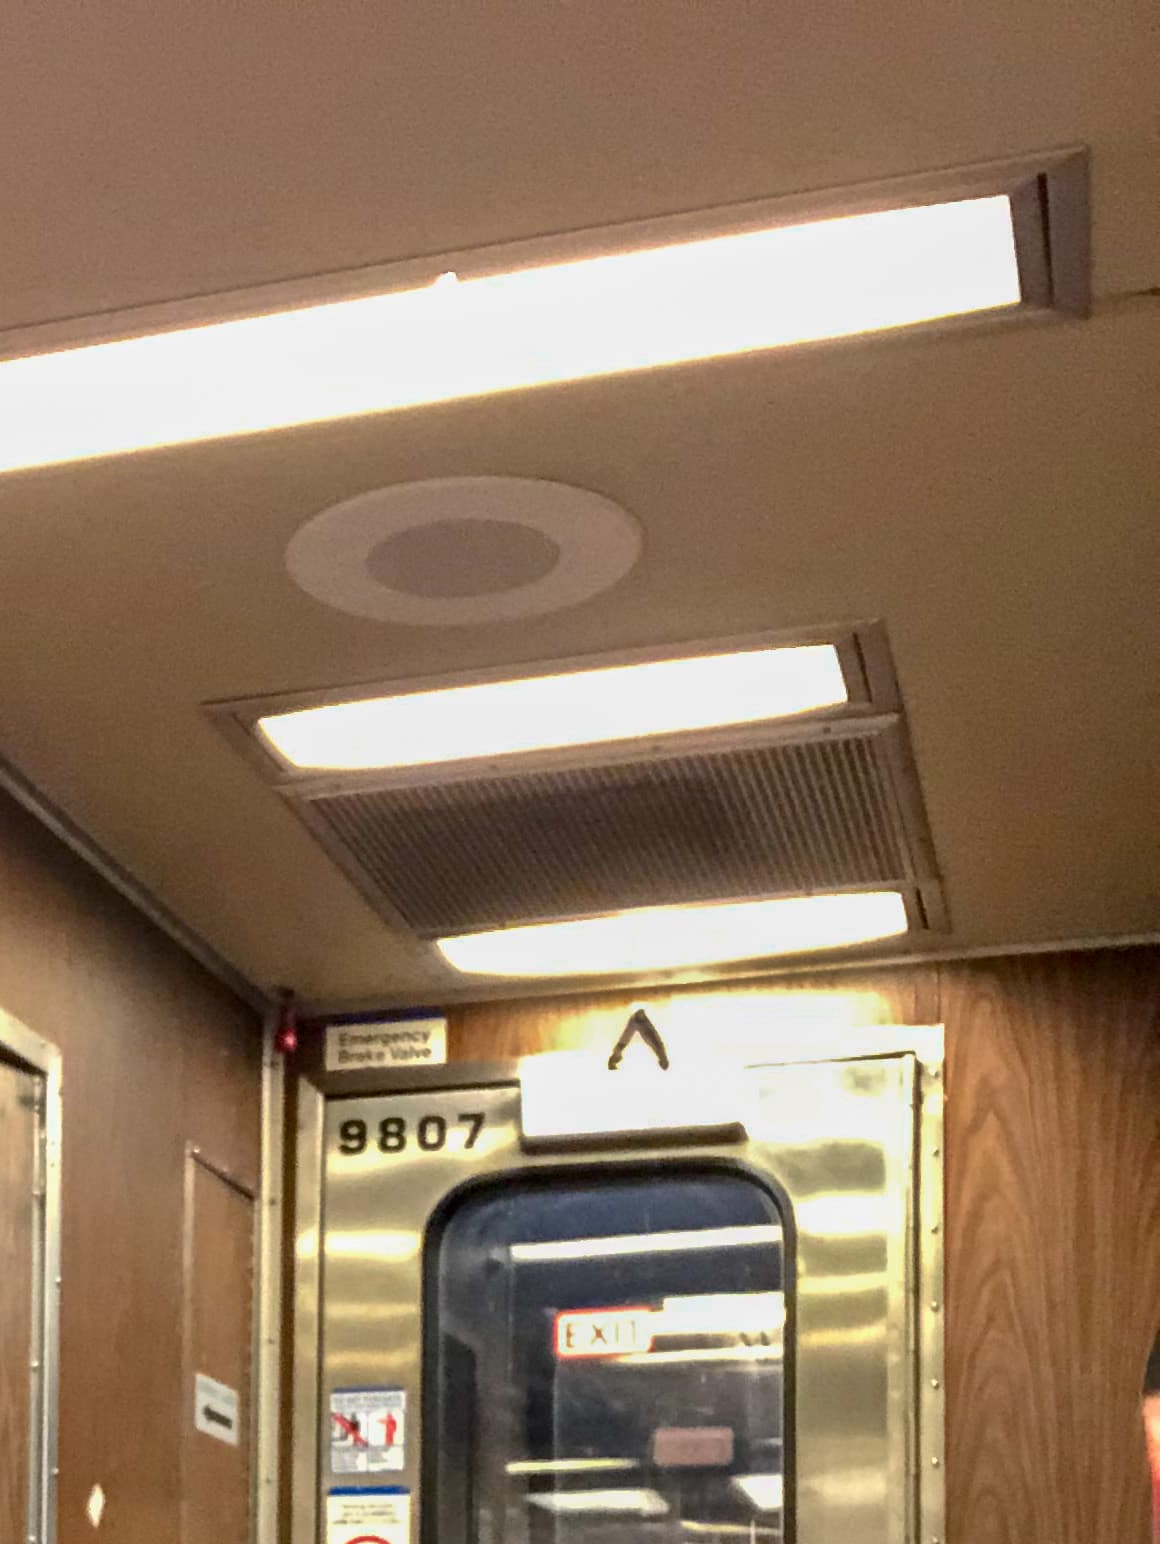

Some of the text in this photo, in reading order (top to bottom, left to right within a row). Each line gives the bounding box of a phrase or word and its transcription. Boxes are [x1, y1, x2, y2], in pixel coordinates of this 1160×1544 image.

[338, 1031, 431, 1047] Emergency
[339, 1112, 485, 1156] 9807
[565, 1320, 639, 1349] EXIT
